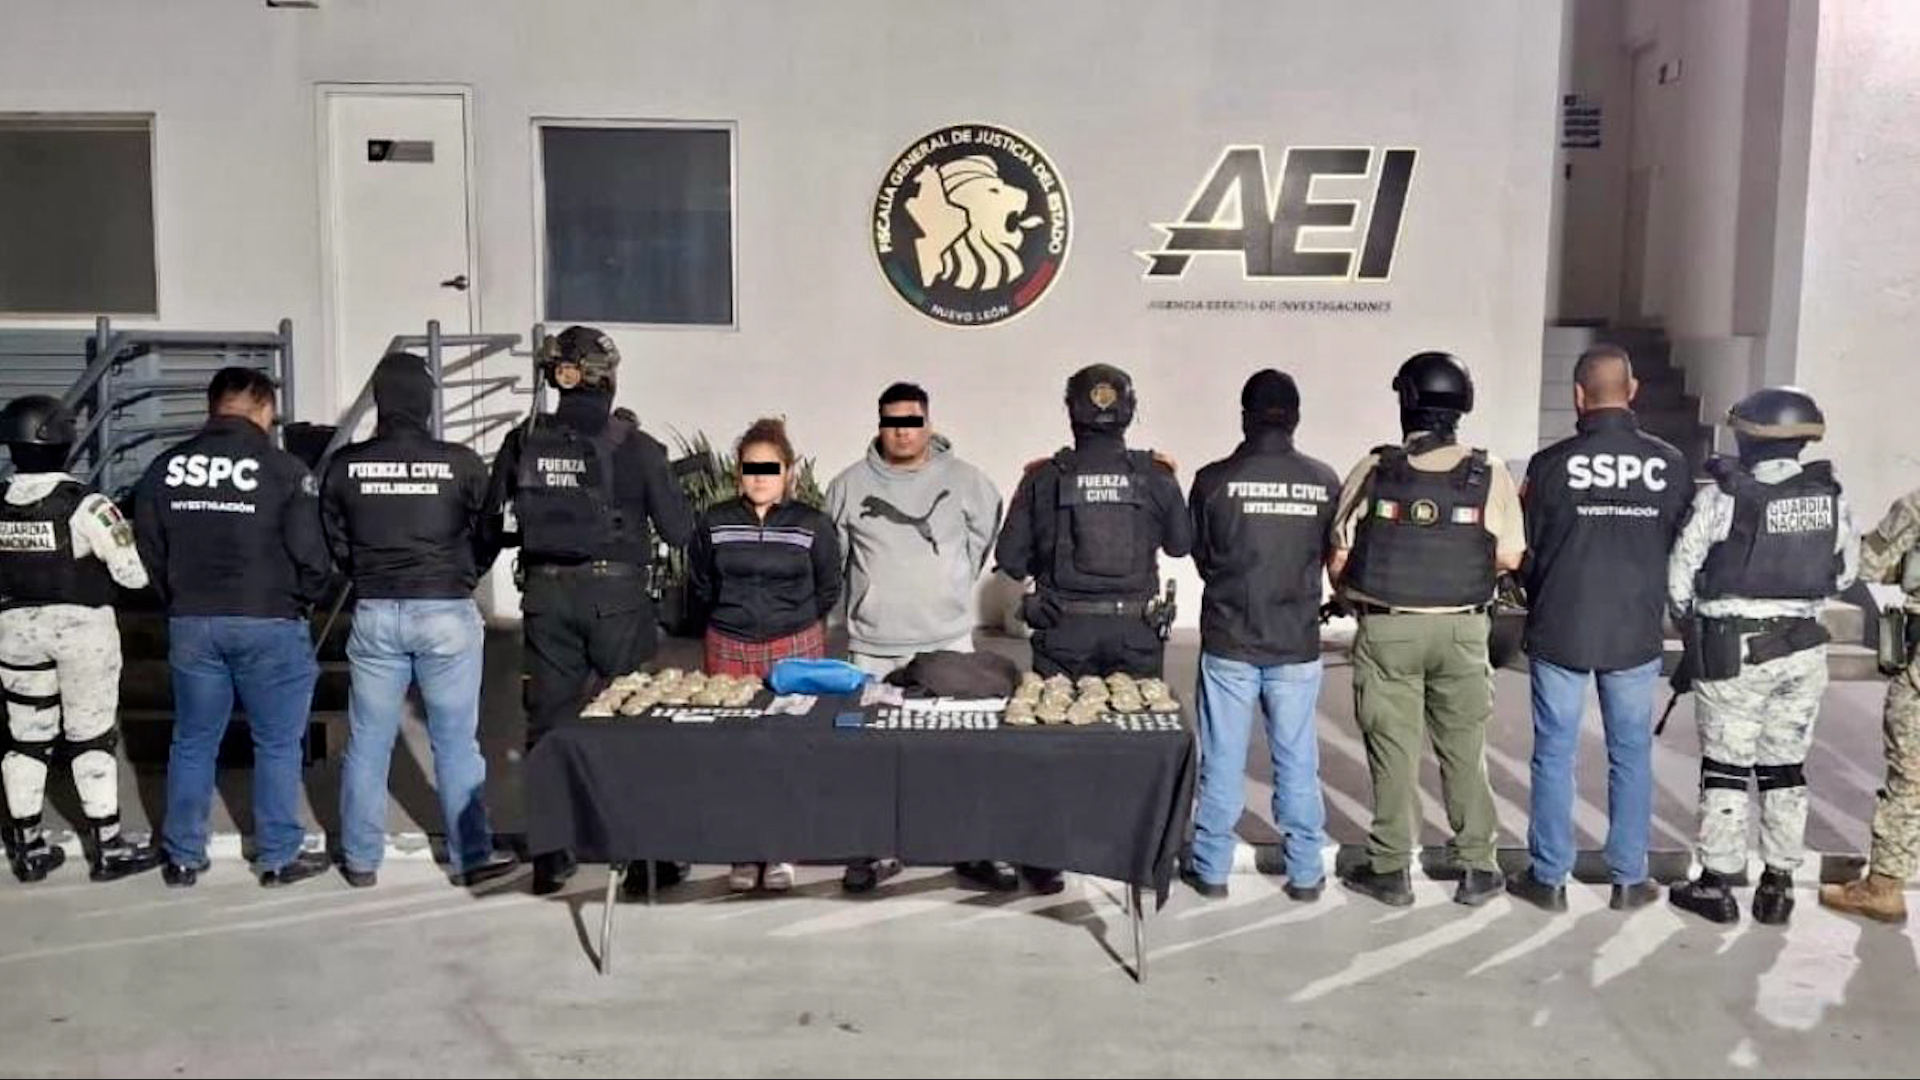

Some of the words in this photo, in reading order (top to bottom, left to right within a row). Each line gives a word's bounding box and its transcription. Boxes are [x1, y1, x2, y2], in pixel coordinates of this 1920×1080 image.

[890, 134, 949, 186] GENERAL
[951, 129, 972, 144] DE
[974, 130, 1034, 167] JUSTICIA
[1032, 162, 1055, 192] DEL
[1047, 191, 1065, 254] ESTADO
[1135, 145, 1419, 282] AEI
[1259, 301, 1276, 312] DE
[1279, 301, 1392, 312] INVESTIGACIONES
[165, 454, 259, 491] SSPC
[348, 462, 408, 478] FUERZA
[410, 462, 454, 478] CIVIL
[537, 457, 586, 473] FUERZA
[1567, 453, 1667, 491] SSPC
[546, 472, 579, 487] CIVIL
[1077, 473, 1129, 488] FUERZA
[1086, 488, 1121, 503] CIVIL
[1228, 481, 1287, 498] FUERZA
[1291, 483, 1329, 502] CIVIL
[1768, 497, 1830, 515] GUARDIA
[1768, 513, 1832, 530] NACIONAL
